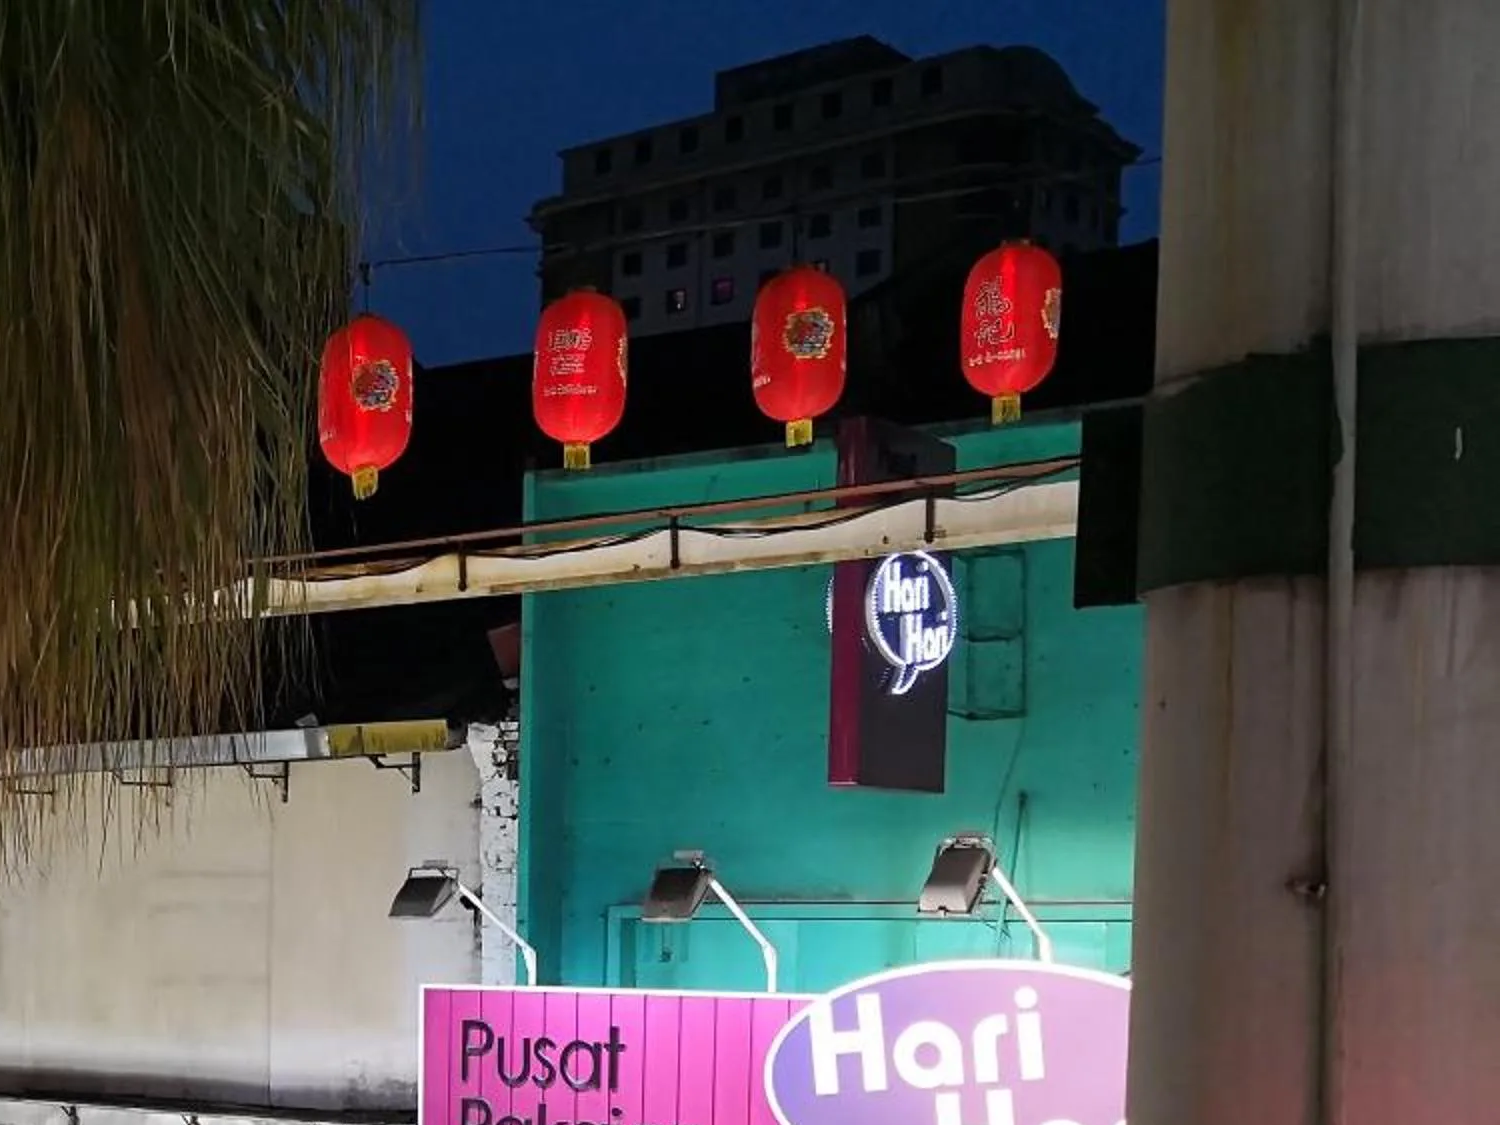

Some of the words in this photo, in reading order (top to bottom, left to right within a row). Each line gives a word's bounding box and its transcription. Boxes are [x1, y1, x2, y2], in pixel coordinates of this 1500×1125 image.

[884, 561, 929, 613] Hari
[901, 611, 948, 664] Hari
[461, 1019, 627, 1092] Pusat
[809, 985, 1045, 1096] Hari
